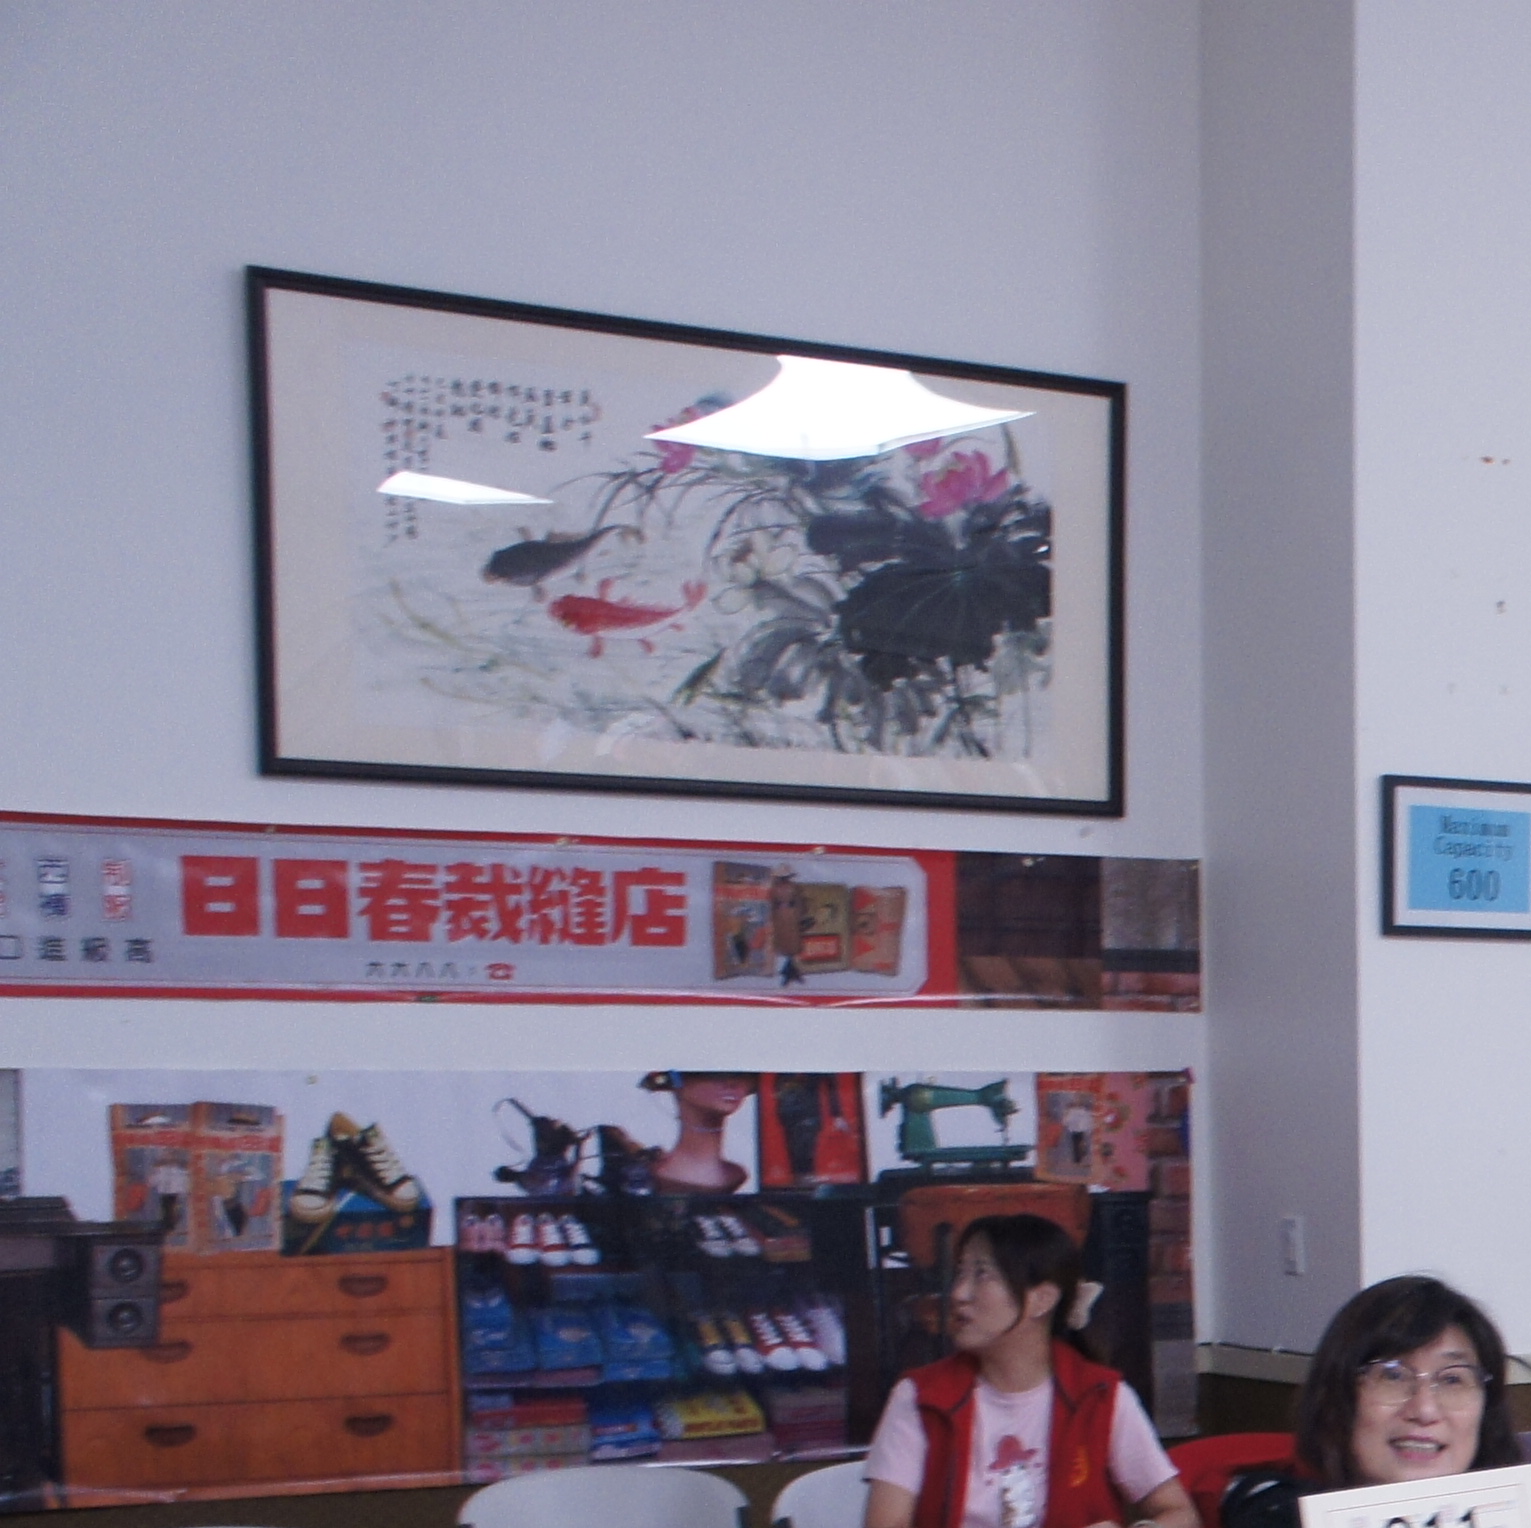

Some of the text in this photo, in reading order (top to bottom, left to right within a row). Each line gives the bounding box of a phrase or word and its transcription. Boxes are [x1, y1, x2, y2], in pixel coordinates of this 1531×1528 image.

[1434, 836, 1512, 861] Capacity
[180, 855, 687, 946] 日日春裁縫店
[1449, 868, 1499, 901] 600
